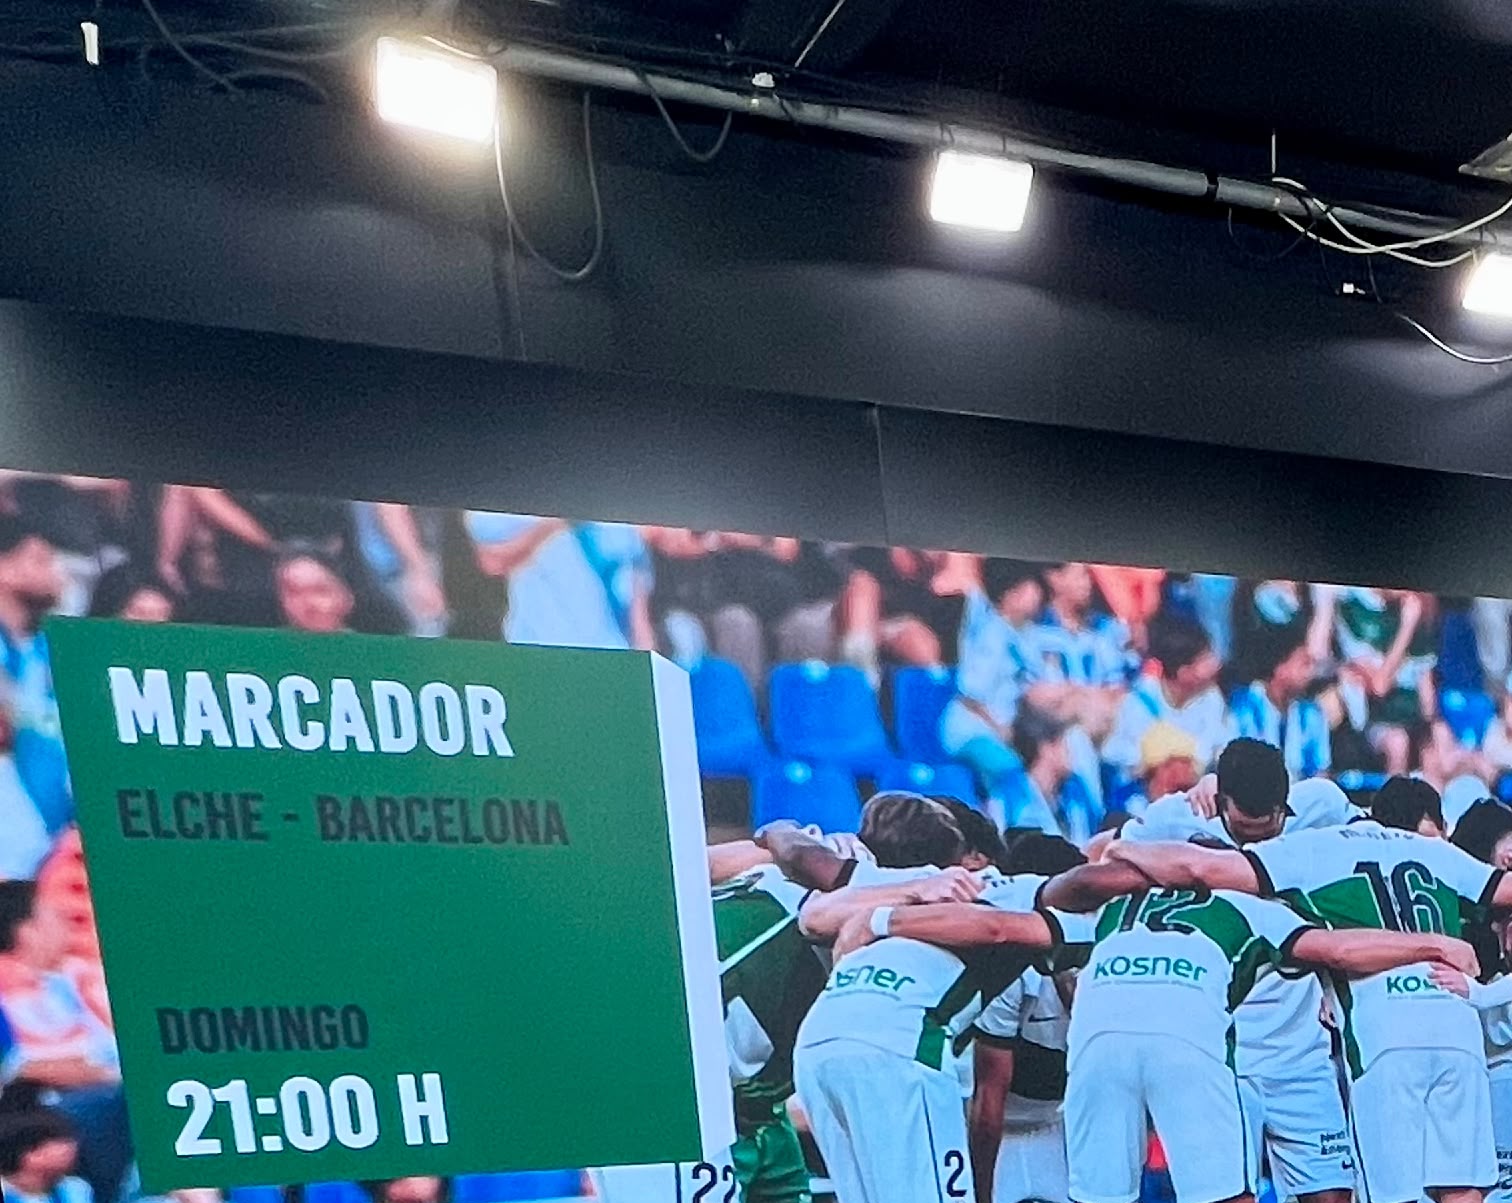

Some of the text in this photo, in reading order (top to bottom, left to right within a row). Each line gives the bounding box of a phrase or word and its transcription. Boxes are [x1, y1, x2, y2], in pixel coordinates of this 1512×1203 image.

[108, 667, 514, 758] MARCADOR
[117, 788, 269, 842] ELCHE
[317, 796, 569, 846] BARCELONA
[1353, 861, 1442, 933] 16
[156, 1004, 369, 1055] DOMINGO
[166, 1072, 450, 1156] 21:00 H
[944, 1150, 967, 1197] 2
